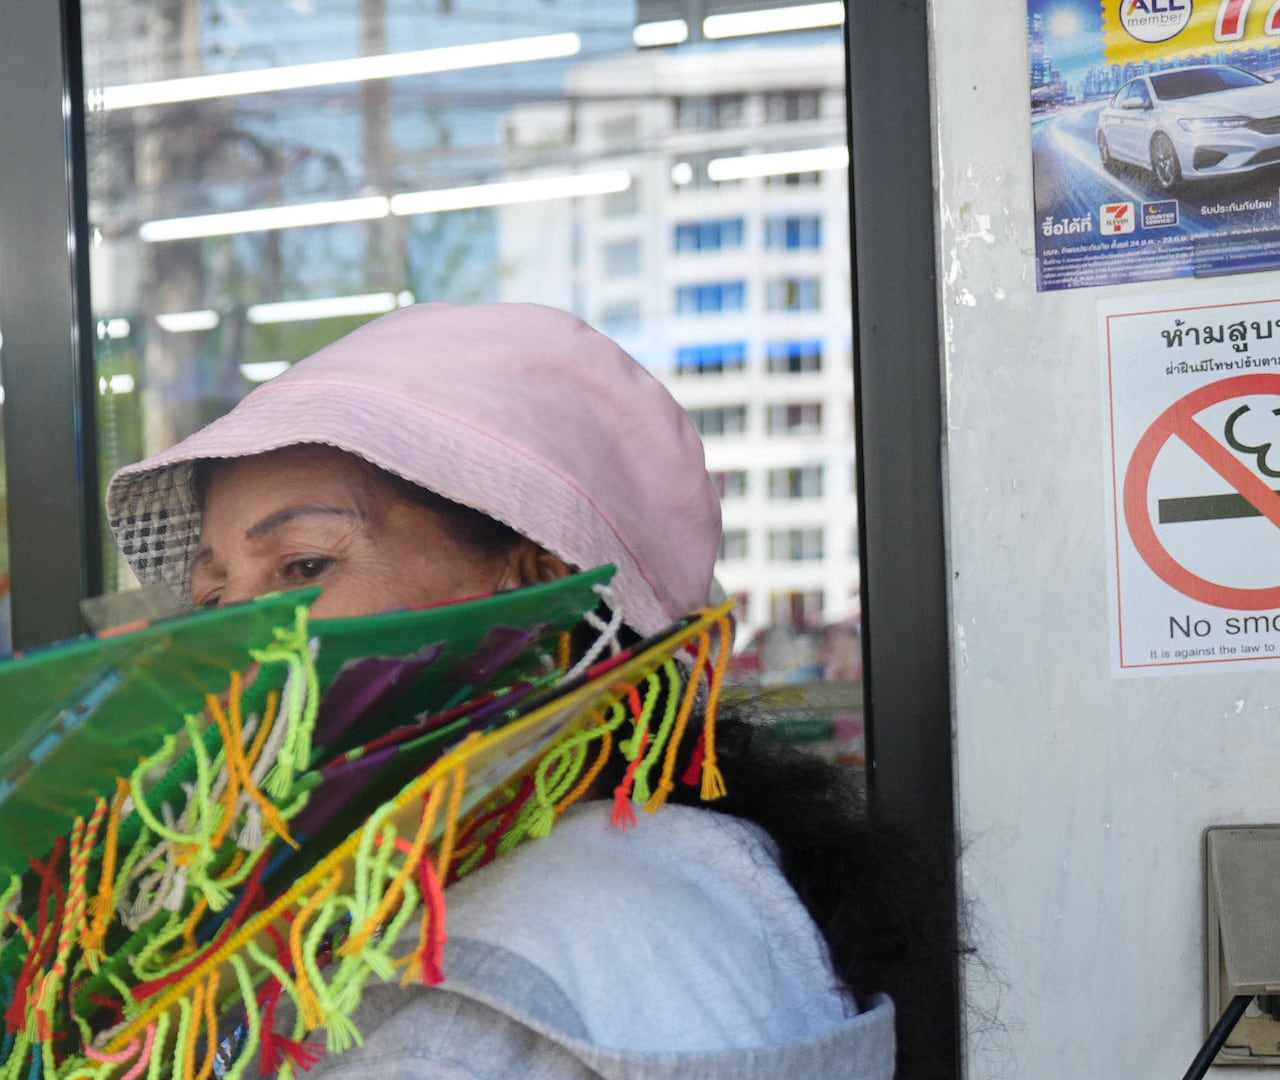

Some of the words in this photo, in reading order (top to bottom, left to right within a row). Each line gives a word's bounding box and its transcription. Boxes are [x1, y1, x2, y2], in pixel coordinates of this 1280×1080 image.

[1127, 14, 1183, 27] member
[1042, 212, 1092, 236] ซื้อได้ที่
[1165, 356, 1280, 375] ฝ่าฝืนมีโทษปรับตา
[1169, 614, 1211, 639] No
[1150, 650, 1157, 659] It
[1161, 649, 1170, 658] is
[1174, 646, 1216, 659] against
[1219, 645, 1237, 654] the
[1241, 644, 1260, 653] law
[1264, 643, 1275, 652] to
